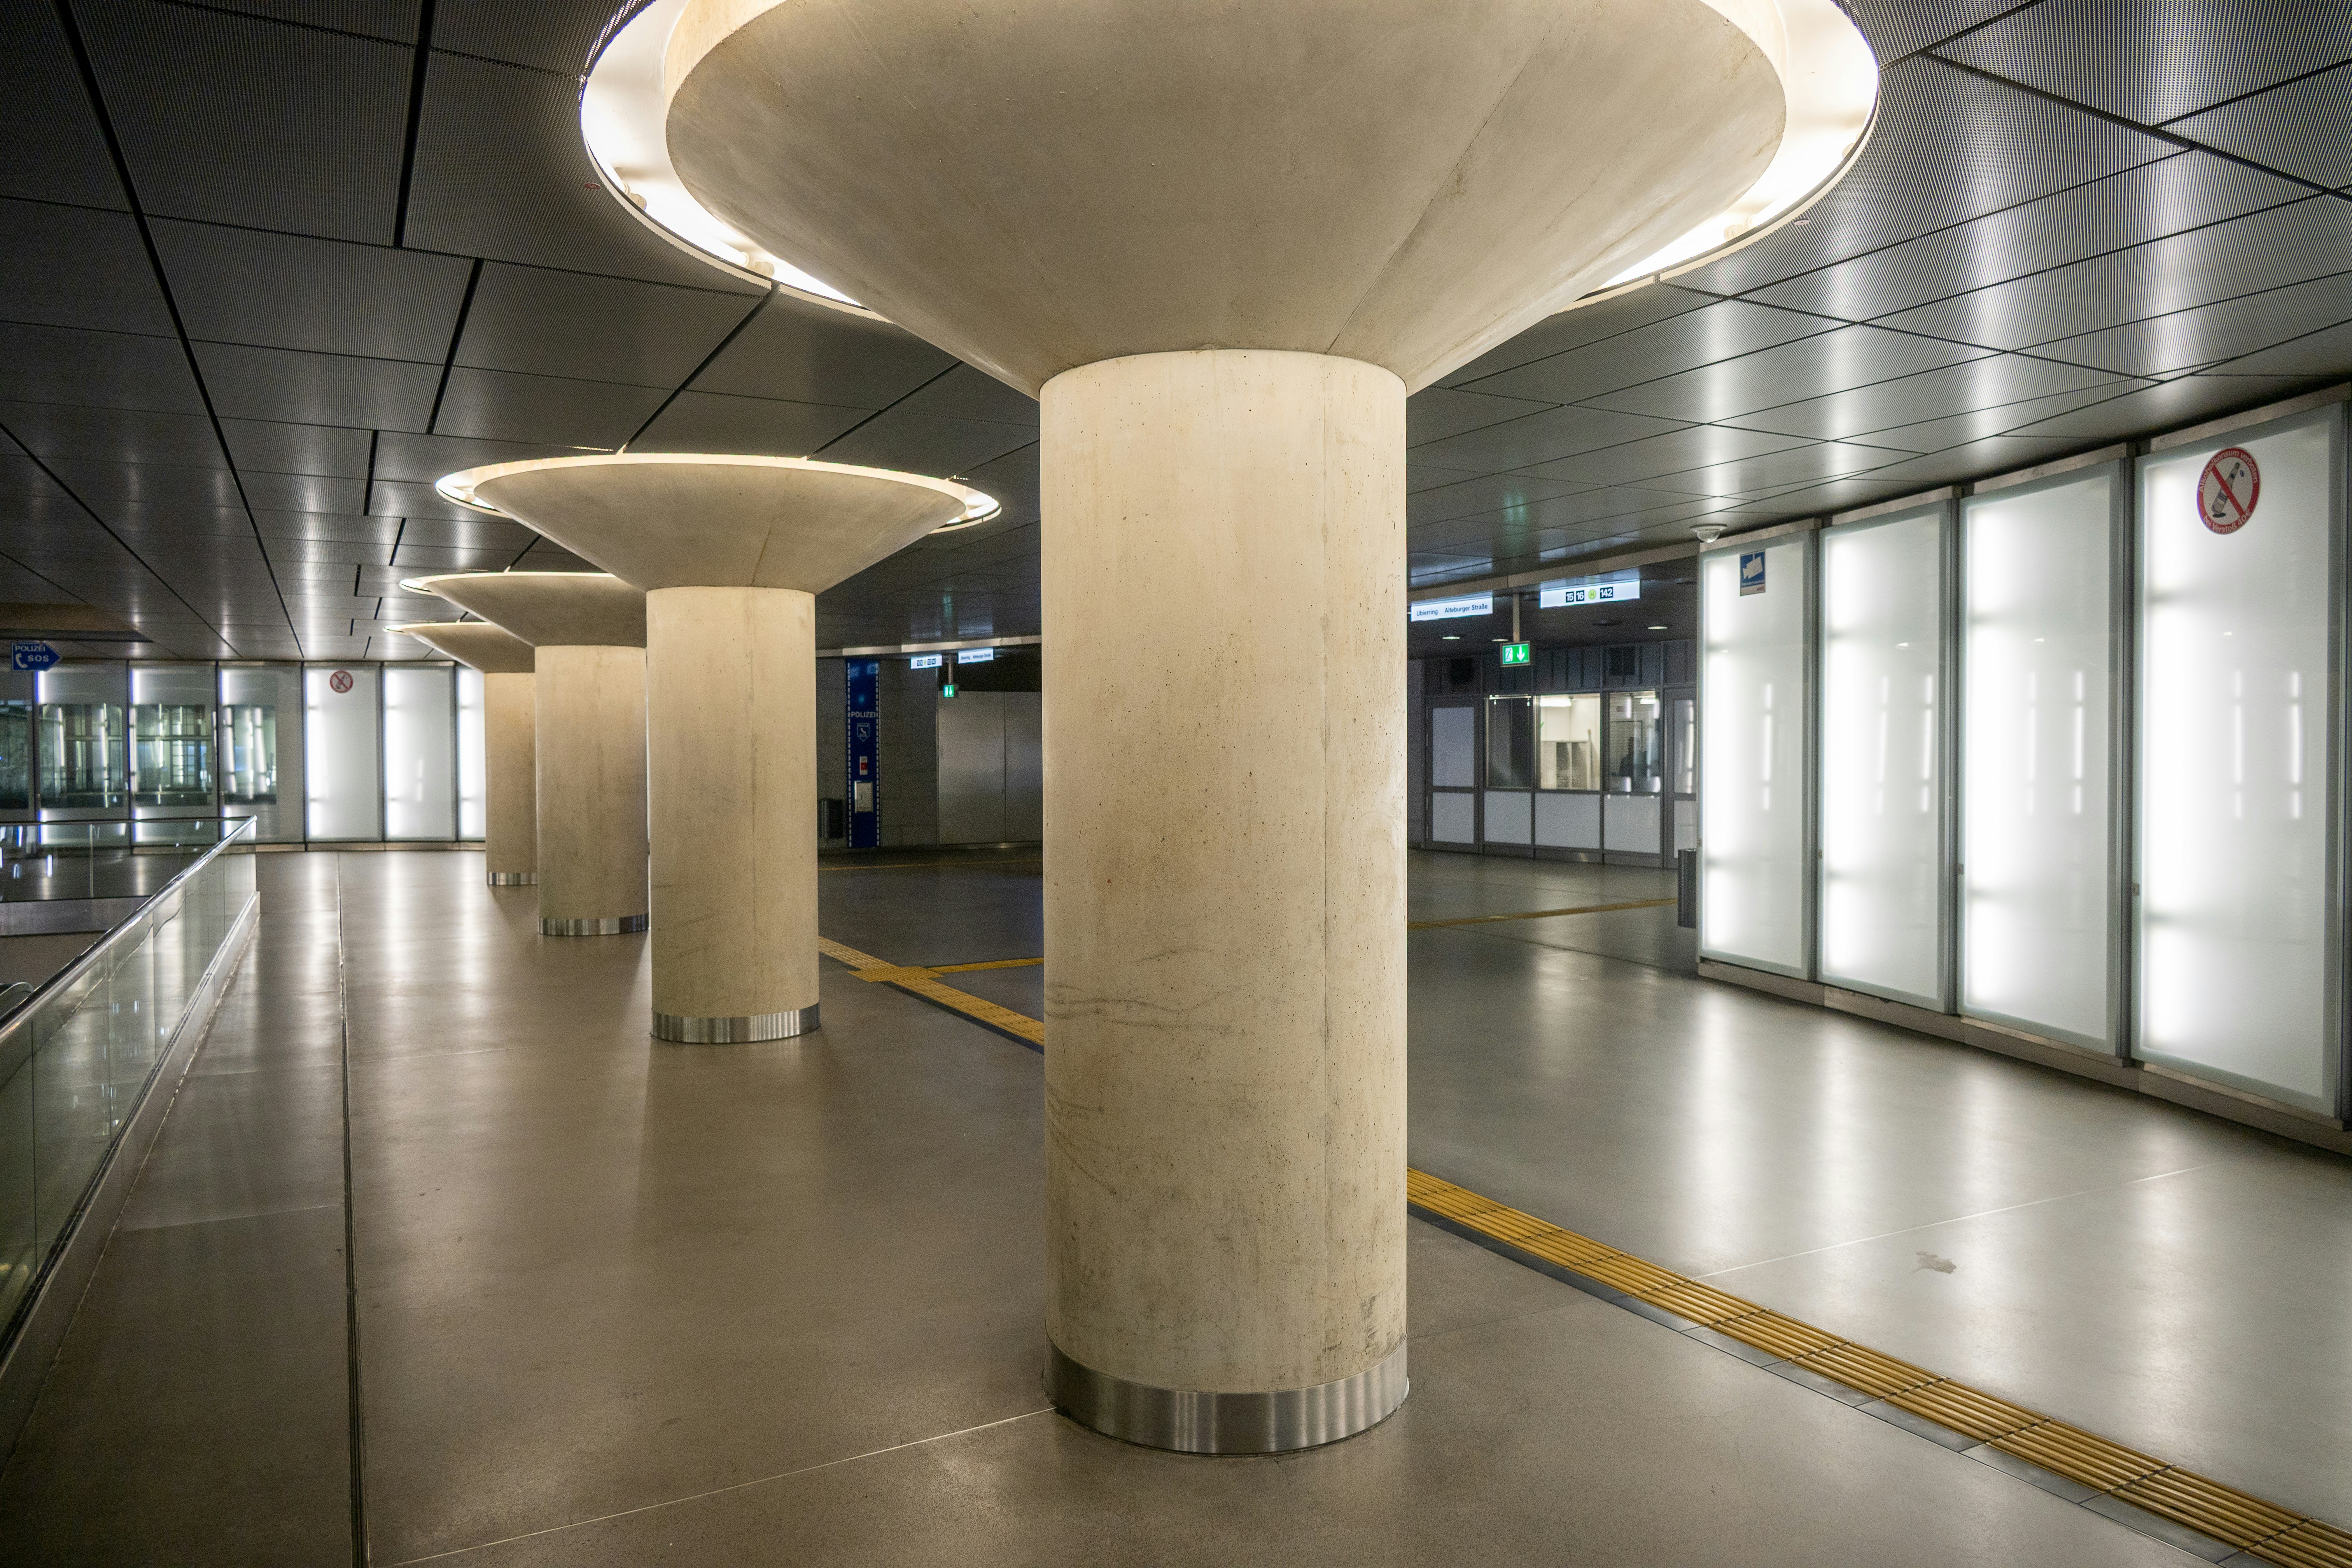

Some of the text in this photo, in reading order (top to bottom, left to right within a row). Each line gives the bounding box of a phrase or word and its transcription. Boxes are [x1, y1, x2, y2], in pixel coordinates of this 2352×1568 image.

[2199, 450, 2258, 492] Alkoholkonsum verboten
[2212, 522, 2237, 533] Verstoß
[1566, 592, 1574, 602] 15
[1576, 591, 1584, 600] 16
[1600, 588, 1613, 598] 142
